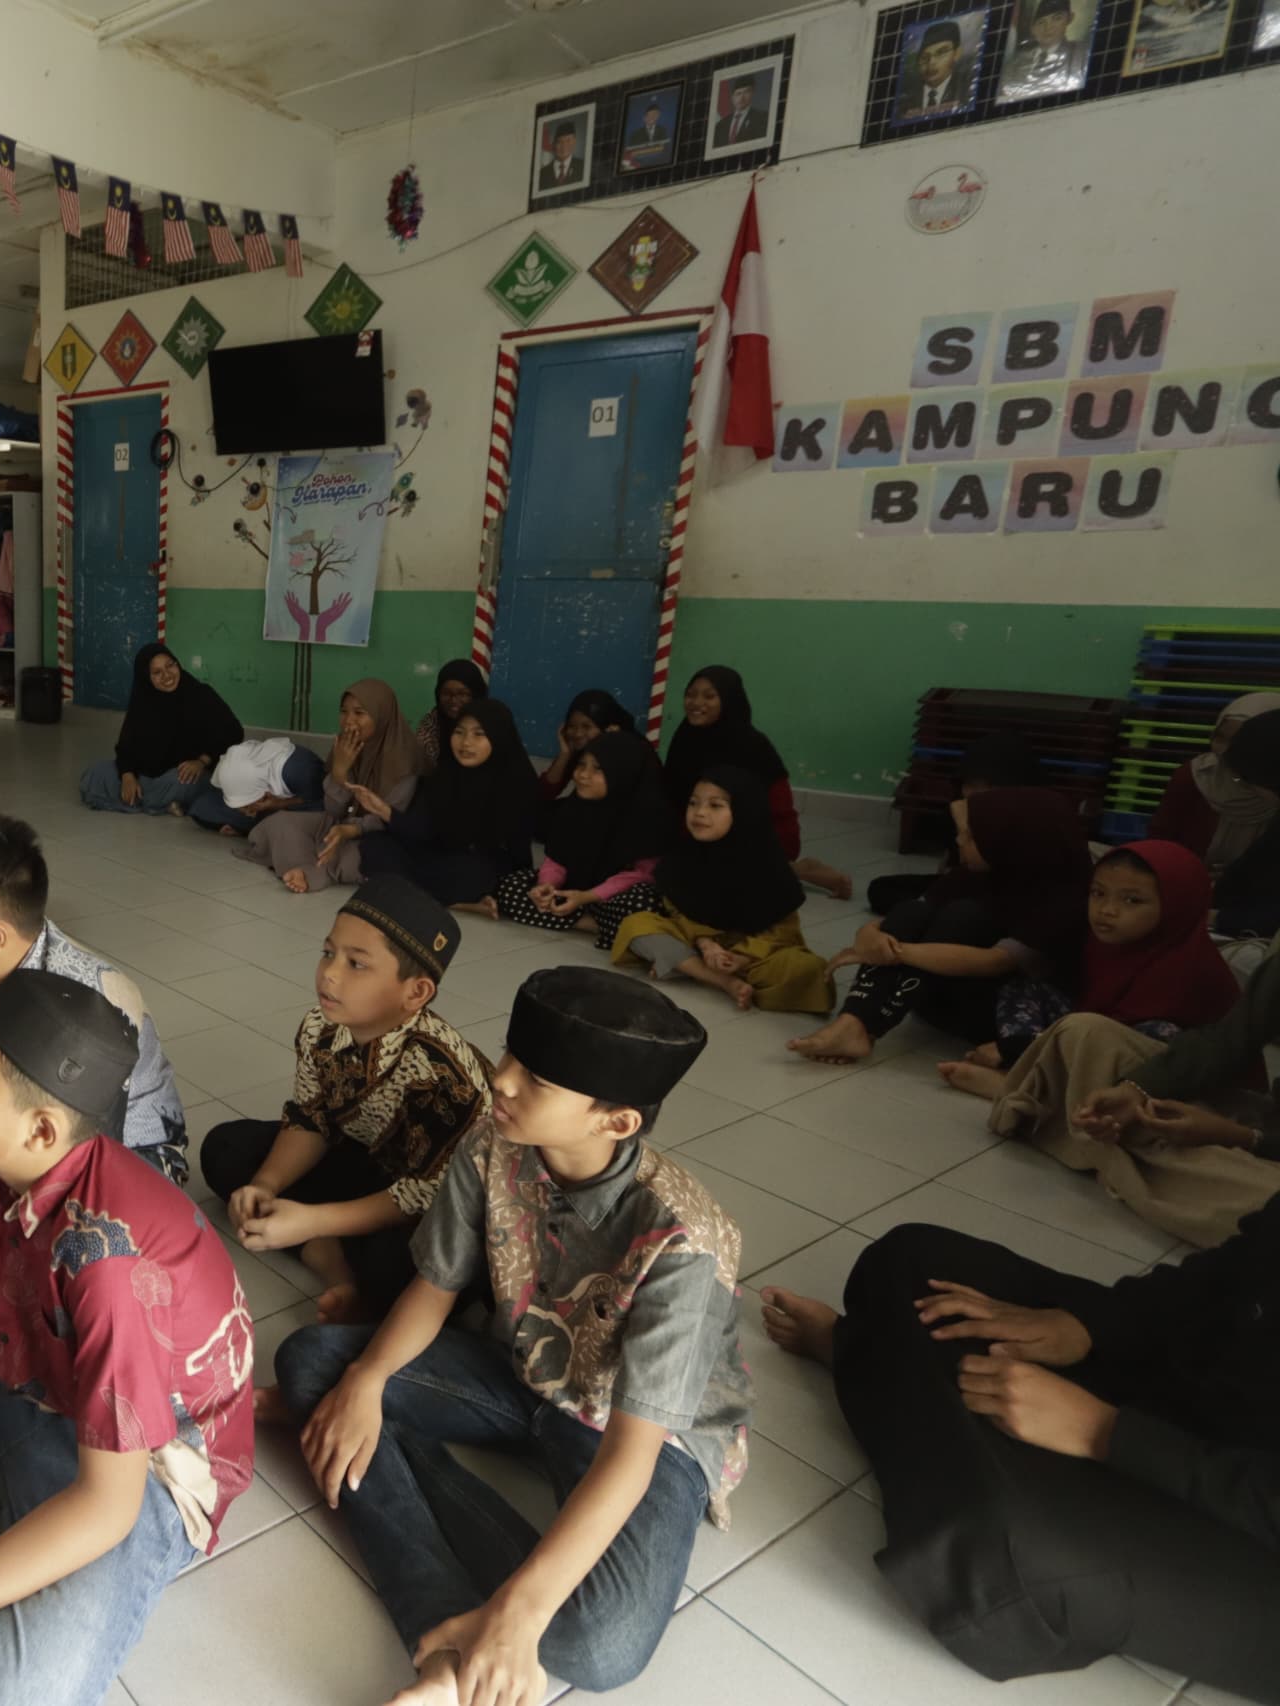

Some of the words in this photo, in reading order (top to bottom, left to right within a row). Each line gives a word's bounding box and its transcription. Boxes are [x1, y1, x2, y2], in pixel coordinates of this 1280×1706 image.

[926, 305, 1166, 376] SBM
[592, 405, 615, 424] 01
[115, 448, 128, 462] 02
[871, 467, 1163, 525] BARU
